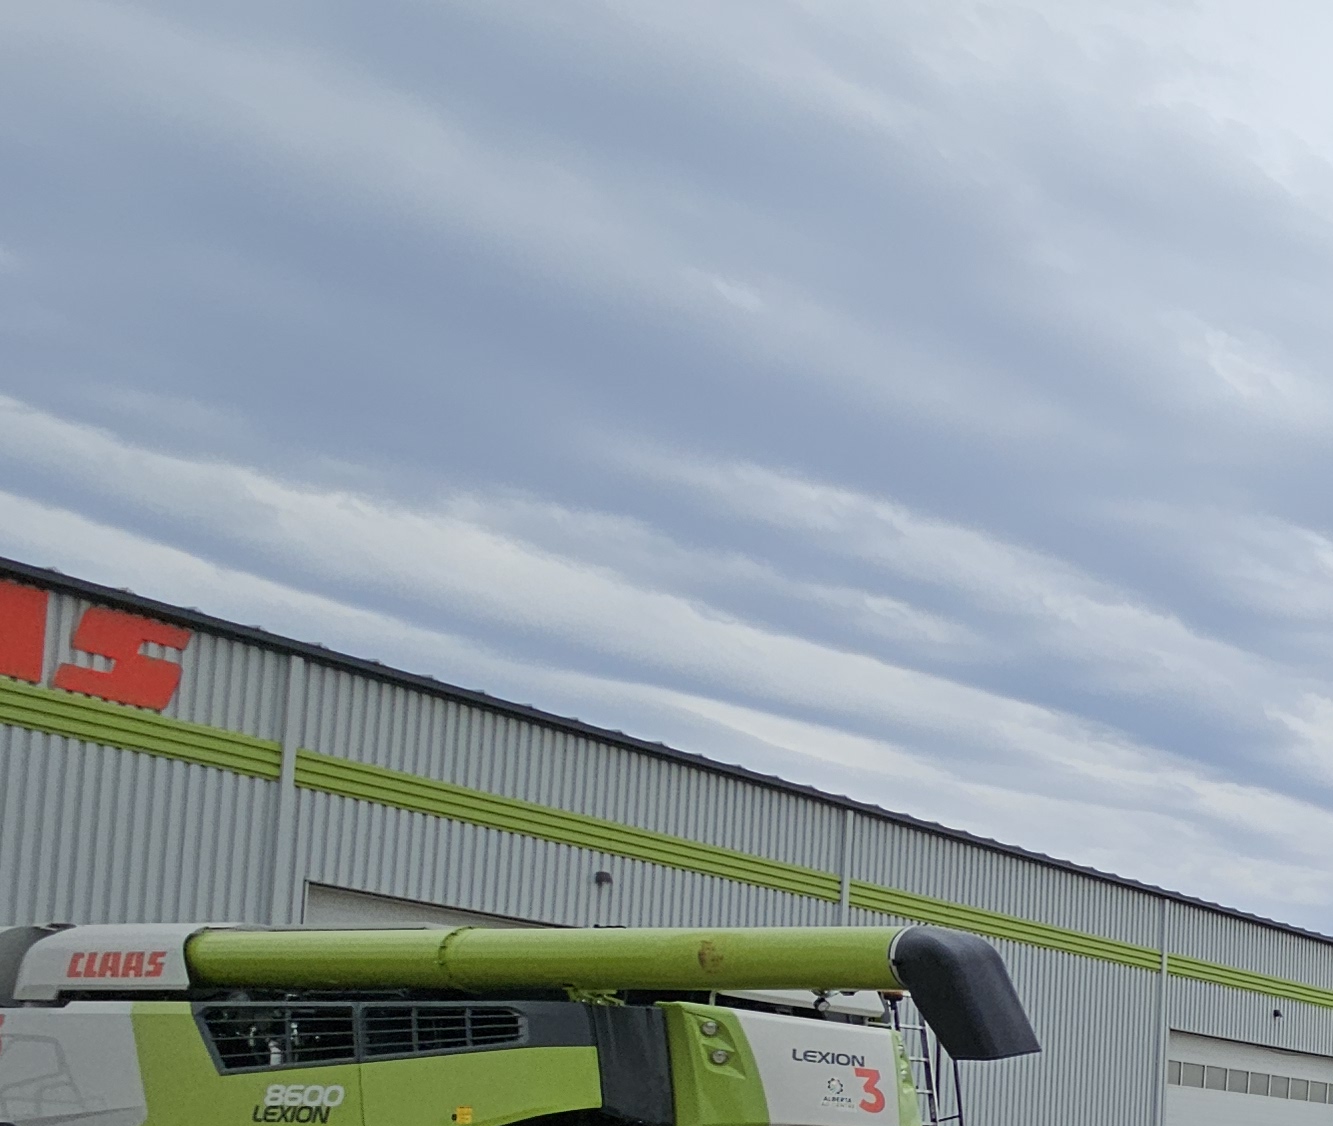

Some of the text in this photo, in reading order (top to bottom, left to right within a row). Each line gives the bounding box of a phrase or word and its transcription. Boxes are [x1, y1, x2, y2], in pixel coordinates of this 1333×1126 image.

[66, 951, 168, 978] CLAAS
[791, 1048, 866, 1067] LEXION
[264, 1084, 345, 1107] 8600
[854, 1067, 886, 1114] 3
[252, 1105, 331, 1124] LEXION
